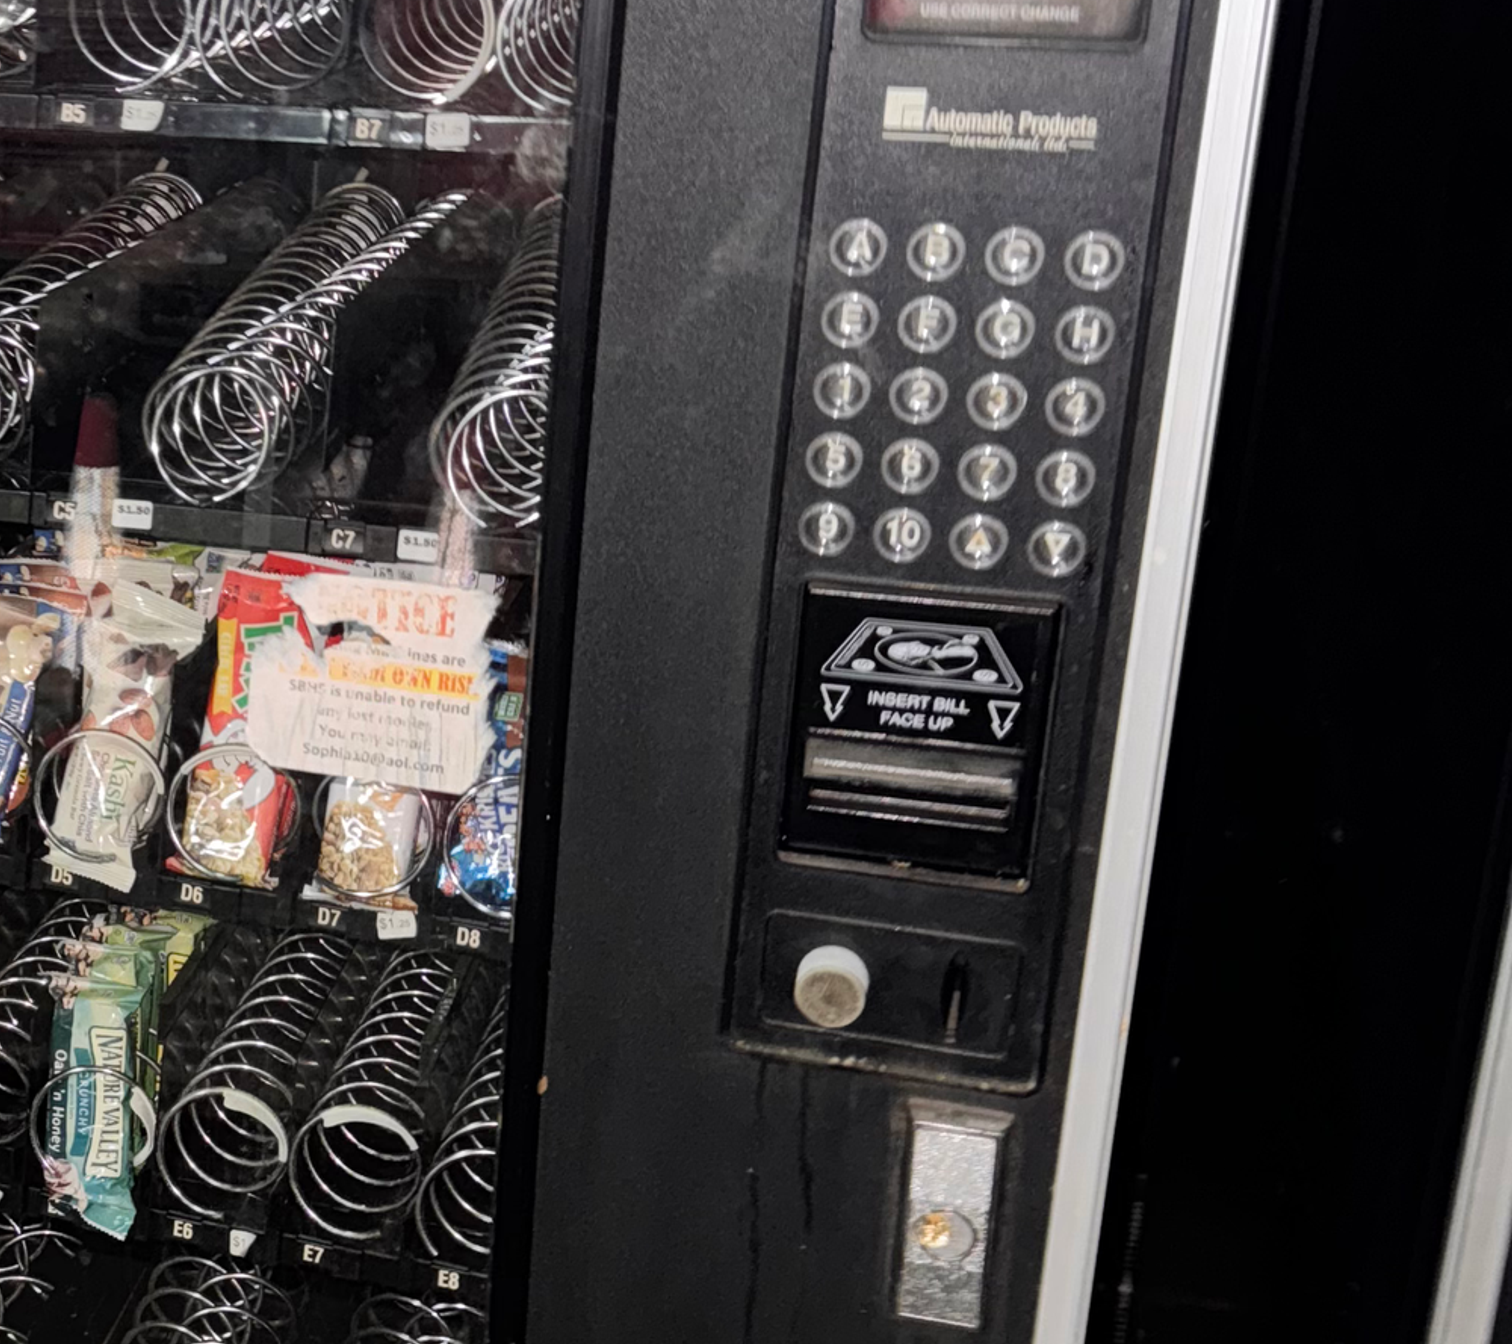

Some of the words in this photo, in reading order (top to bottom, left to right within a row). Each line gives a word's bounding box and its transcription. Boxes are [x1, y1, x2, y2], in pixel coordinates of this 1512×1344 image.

[1020, 4, 1081, 24] CHANGE
[59, 101, 87, 124] B5
[925, 106, 1014, 135] Automatic
[1018, 110, 1099, 139] Products
[354, 117, 383, 141] B7
[847, 230, 872, 262] A
[1081, 243, 1110, 275] D
[840, 303, 863, 335] E
[917, 307, 940, 338] F
[1071, 318, 1099, 349] H
[837, 376, 852, 404] 1
[909, 380, 932, 411] 2
[1063, 391, 1087, 423] 4
[979, 456, 1000, 488] 7
[1055, 461, 1078, 494] 8
[115, 504, 152, 518] $1.50
[331, 527, 356, 549] C7
[819, 514, 840, 543] 9
[887, 517, 922, 548] 10
[330, 684, 342, 697] is
[345, 688, 397, 706] unable
[400, 693, 417, 708] to
[420, 697, 471, 716] refund
[867, 689, 930, 713] INSERT
[933, 695, 971, 716] BILL
[318, 723, 346, 740] You
[879, 709, 926, 729] FACE
[929, 714, 954, 732] UP
[50, 866, 74, 886] D5
[180, 882, 204, 904] D6
[316, 906, 342, 927] D7
[456, 926, 482, 949] D8
[48, 1106, 65, 1154] Honey
[91, 1105, 121, 1174] VALLEY
[173, 1219, 193, 1239] E6
[303, 1244, 324, 1264] E7
[437, 1269, 460, 1290] E8
